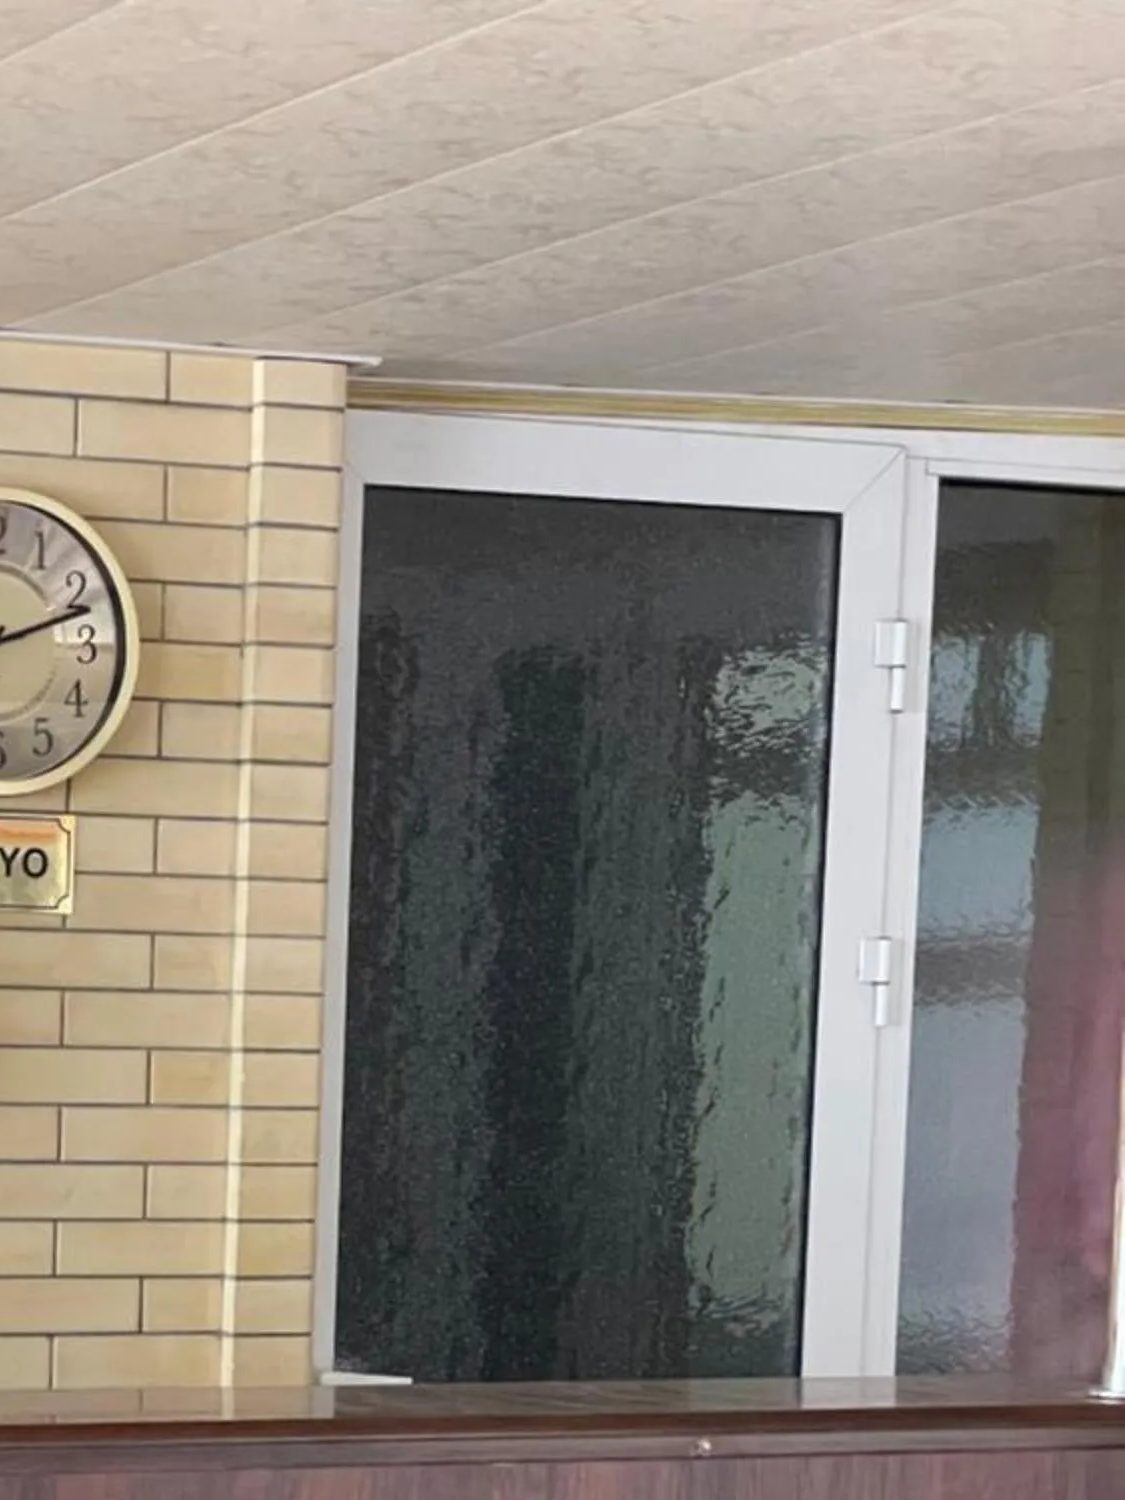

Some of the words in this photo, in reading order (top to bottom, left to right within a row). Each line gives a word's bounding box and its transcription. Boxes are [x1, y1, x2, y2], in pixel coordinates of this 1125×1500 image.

[35, 531, 46, 570] 1
[65, 571, 87, 609] 2
[76, 624, 97, 664] 3
[64, 679, 88, 717] 4
[32, 717, 54, 757] 5
